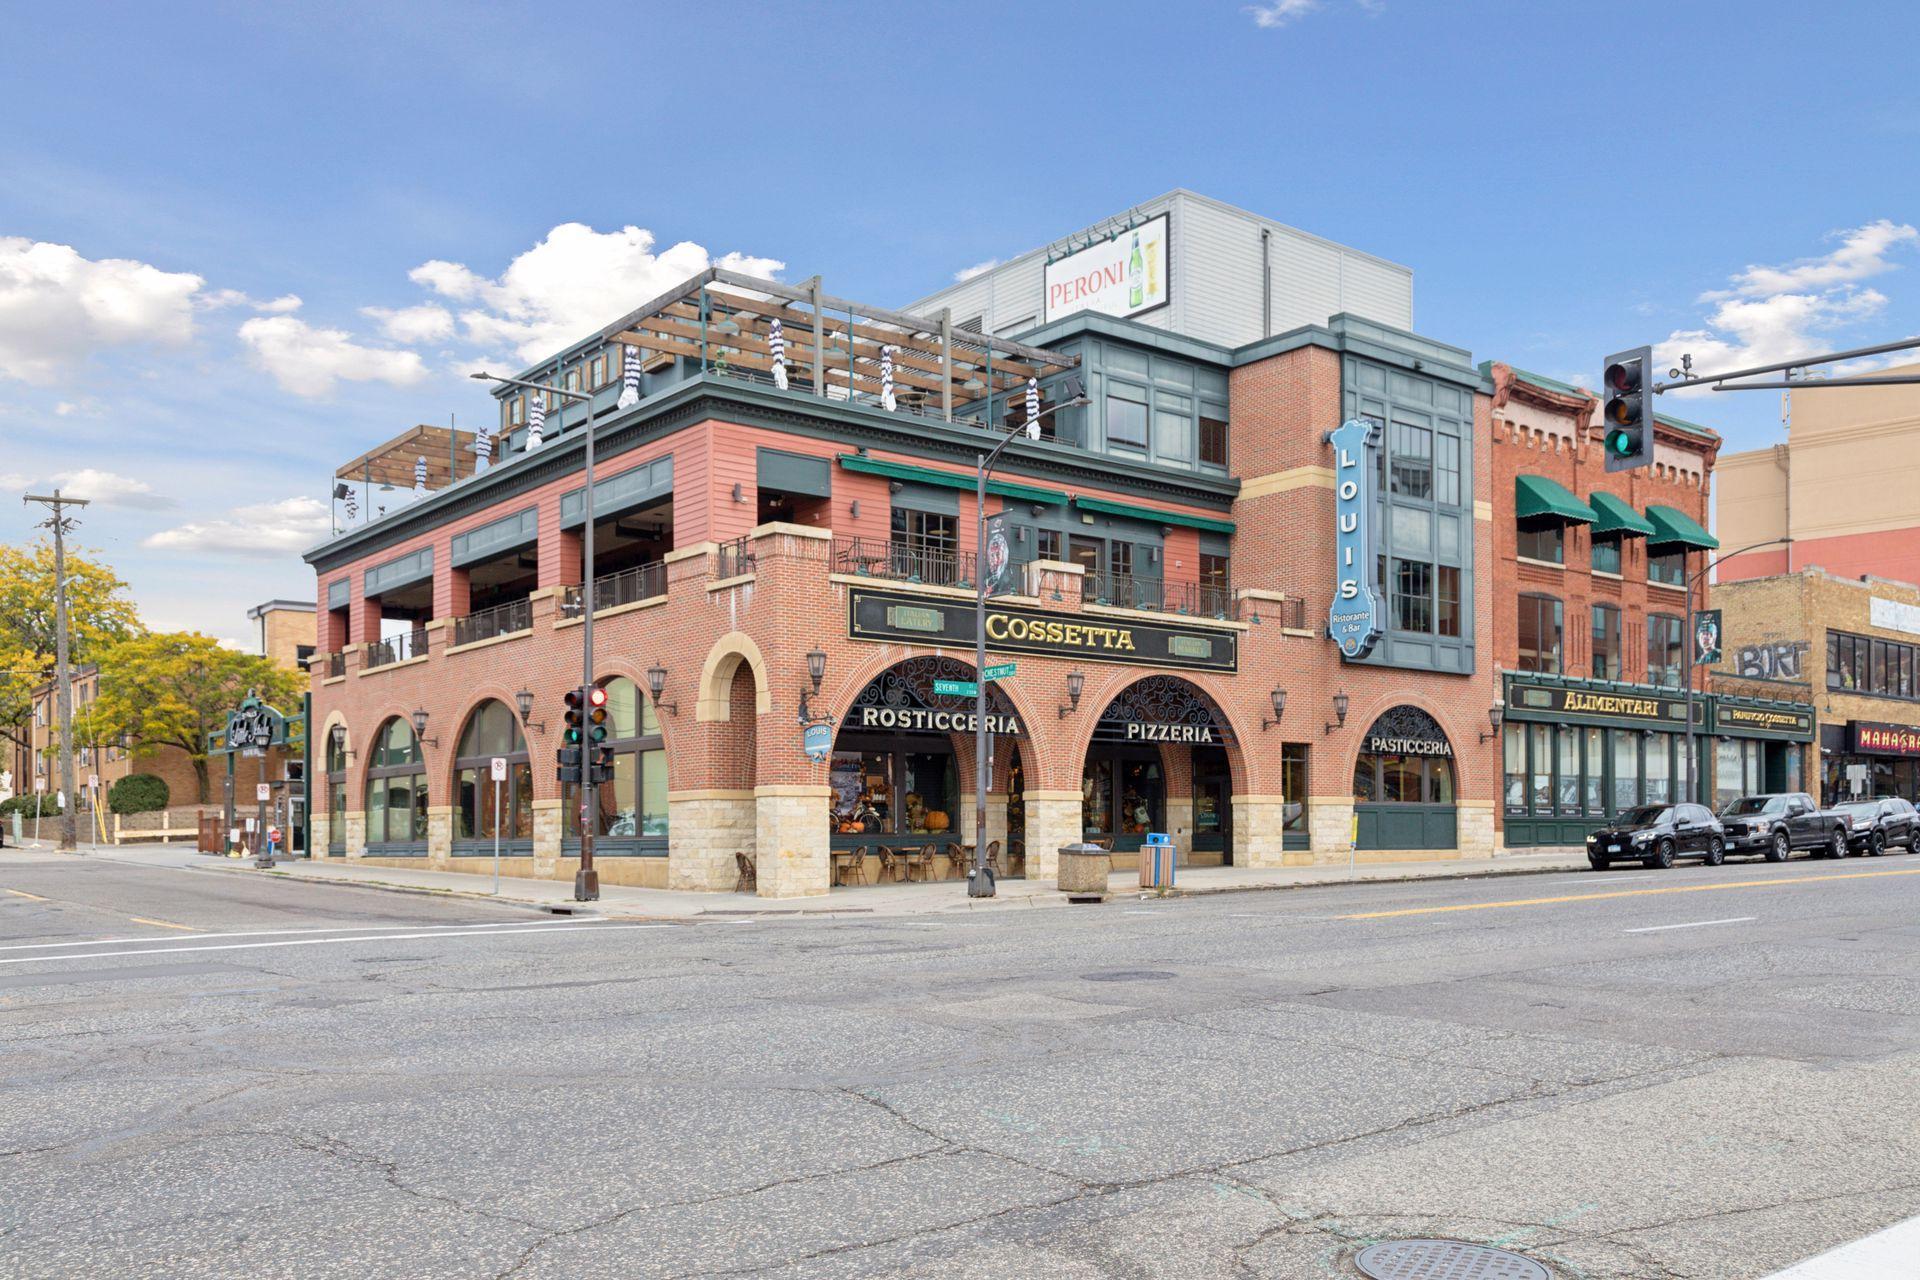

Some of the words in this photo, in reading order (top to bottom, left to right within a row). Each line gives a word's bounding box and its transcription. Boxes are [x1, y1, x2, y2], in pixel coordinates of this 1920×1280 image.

[1050, 260, 1124, 309] PERONI
[1339, 448, 1359, 599] LOUIS
[1333, 611, 1370, 623] Ristorante
[985, 614, 1136, 650] COSSETTA
[1348, 623, 1361, 633] Bar
[984, 666, 1010, 677] CHESTNUT
[934, 682, 959, 692] SEVENTH
[1563, 691, 1659, 716] ALIMENTARI
[863, 707, 1019, 734] ROSTICCERIA
[807, 727, 827, 737] LOUIS
[1127, 723, 1213, 743] PIZZERIA
[1371, 737, 1452, 755] PASTICCERIA
